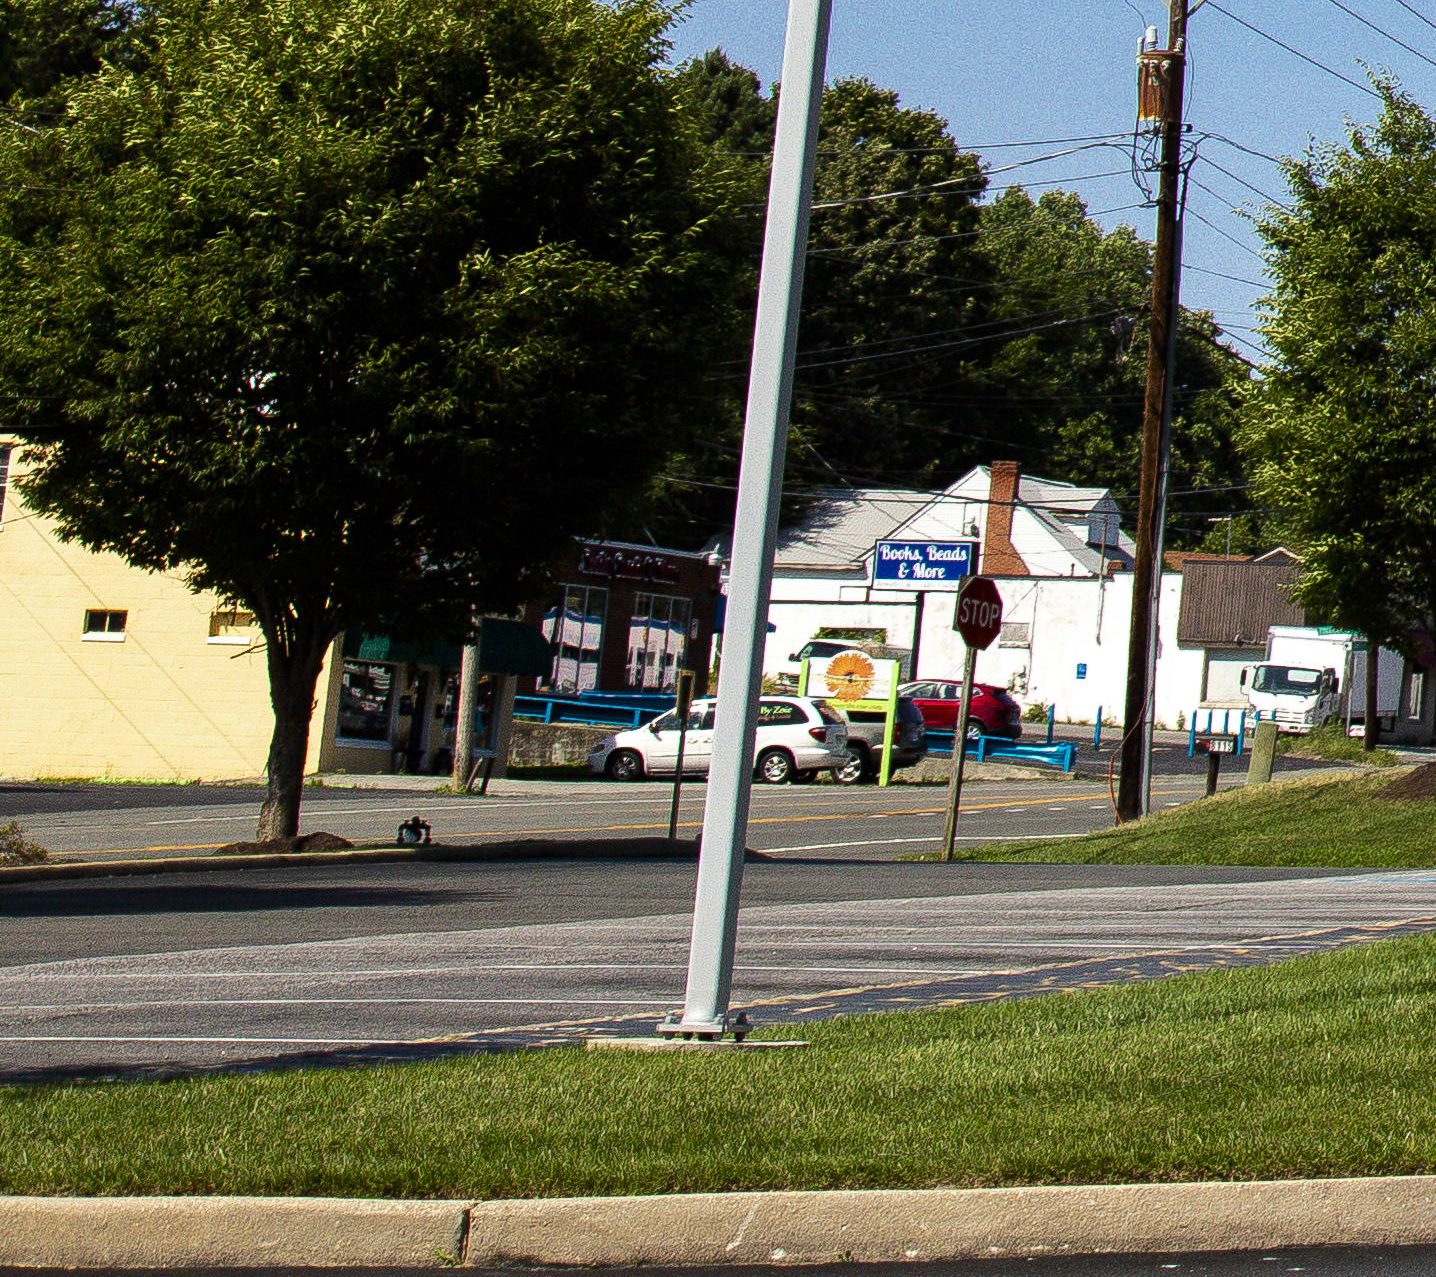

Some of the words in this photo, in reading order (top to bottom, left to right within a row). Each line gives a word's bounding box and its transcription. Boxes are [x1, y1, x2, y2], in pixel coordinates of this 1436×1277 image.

[880, 544, 923, 562] Books,
[927, 545, 967, 561] Beads
[898, 562, 910, 578] &
[912, 563, 946, 579] More
[960, 597, 1000, 629] STOP
